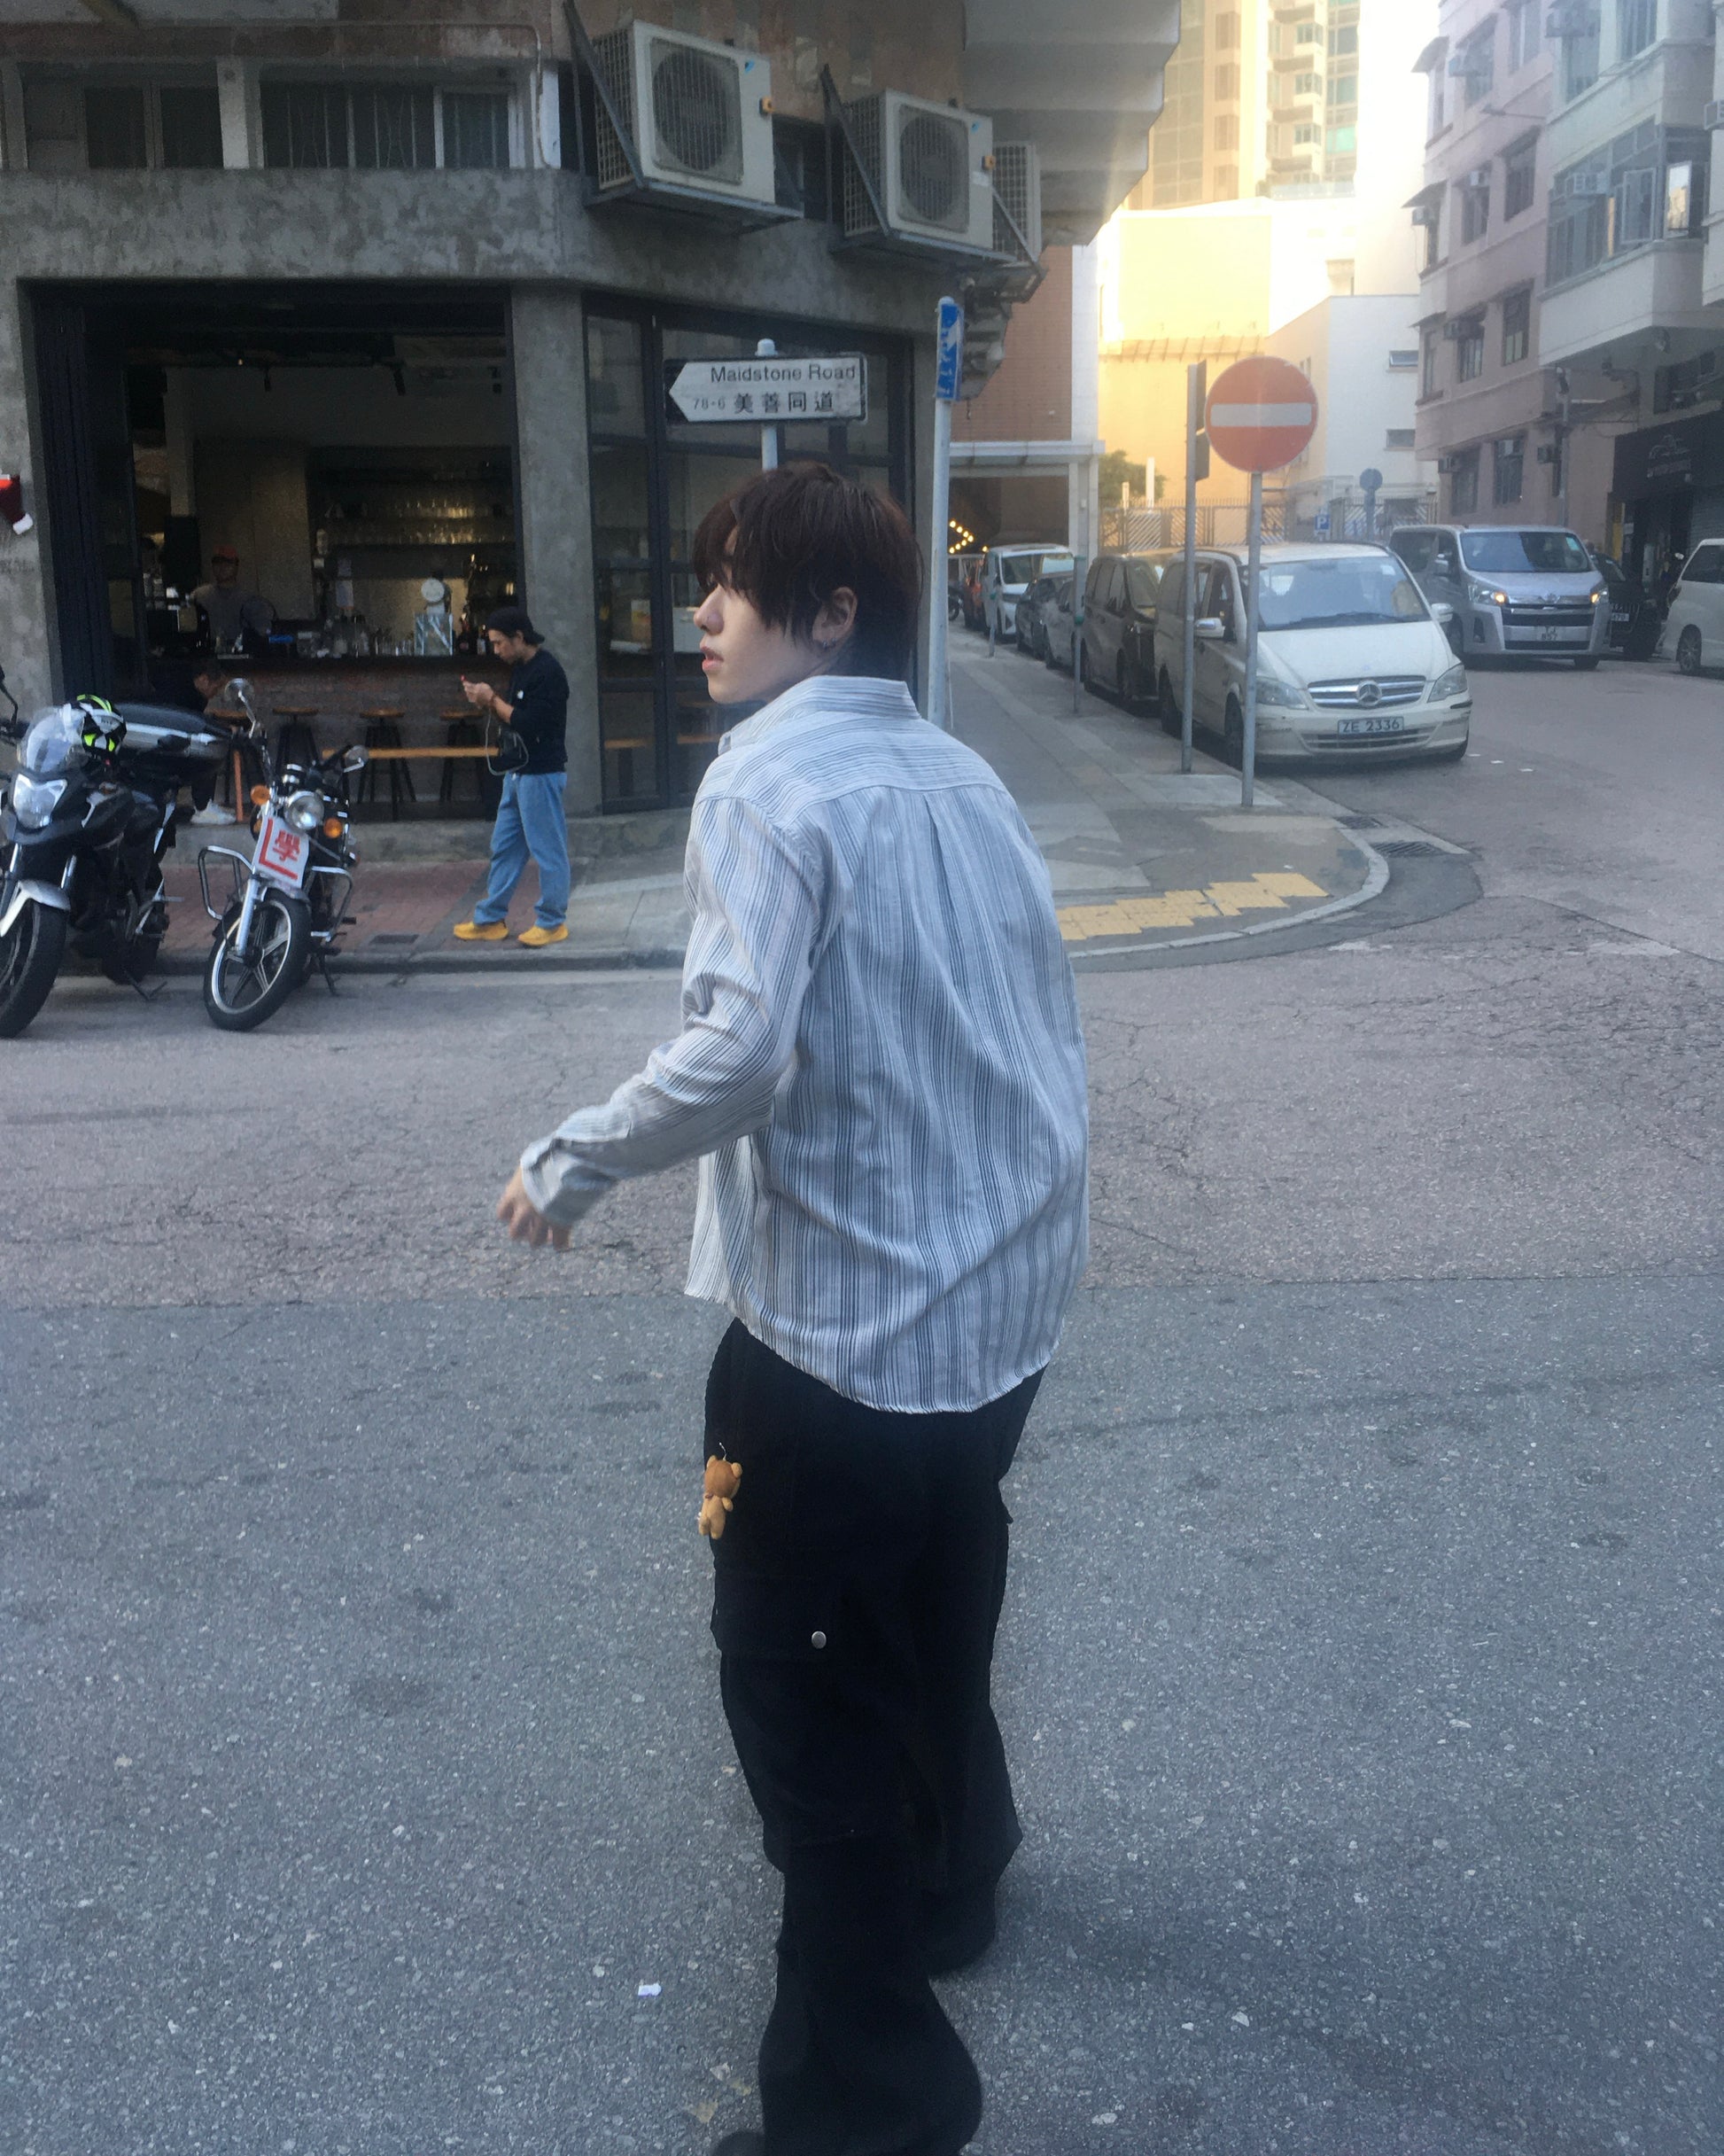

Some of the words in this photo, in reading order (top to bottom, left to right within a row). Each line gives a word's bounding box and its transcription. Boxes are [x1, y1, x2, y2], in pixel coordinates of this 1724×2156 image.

[711, 365, 802, 383] Maidstone
[808, 363, 857, 380] Road
[734, 391, 834, 414] 美善同道
[1342, 721, 1360, 733] ZE
[1365, 719, 1400, 732] 2336
[259, 818, 299, 880] L
